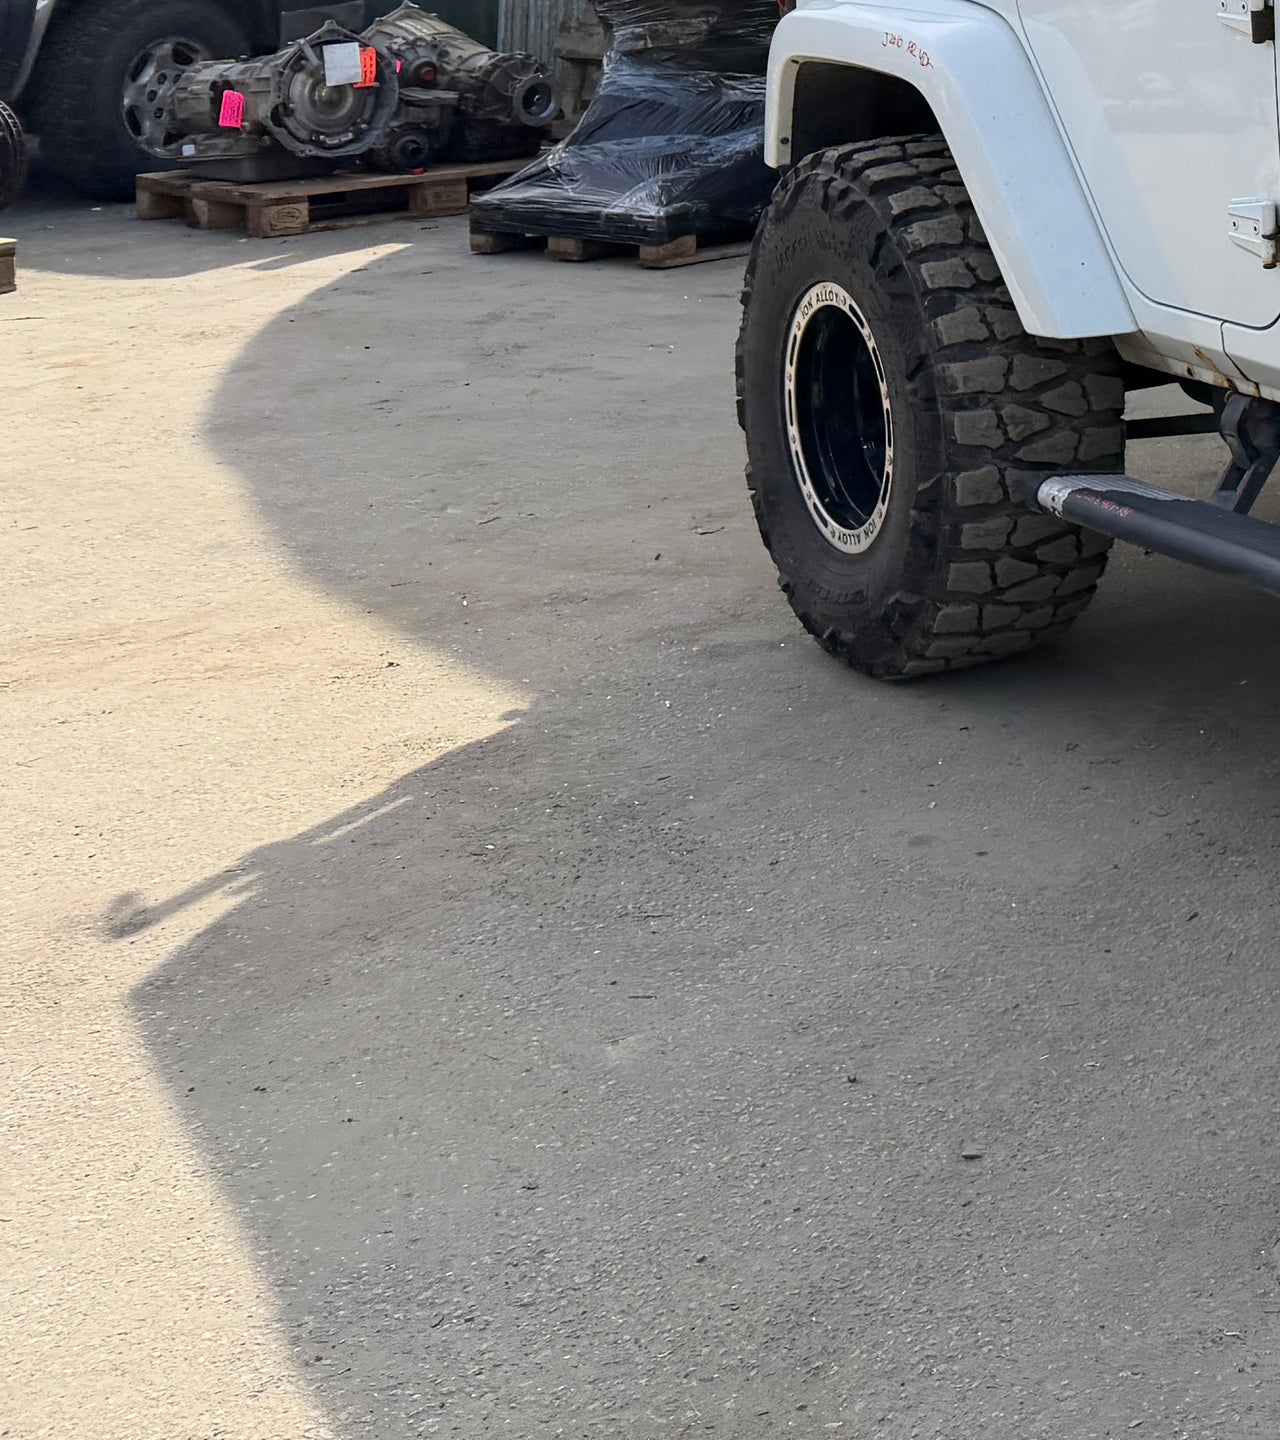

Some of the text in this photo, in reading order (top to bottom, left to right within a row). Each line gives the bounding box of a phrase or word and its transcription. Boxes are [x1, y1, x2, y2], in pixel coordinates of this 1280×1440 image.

[800, 289, 839, 319] ION ALLOY
[837, 519, 877, 546] ION ALLOY
